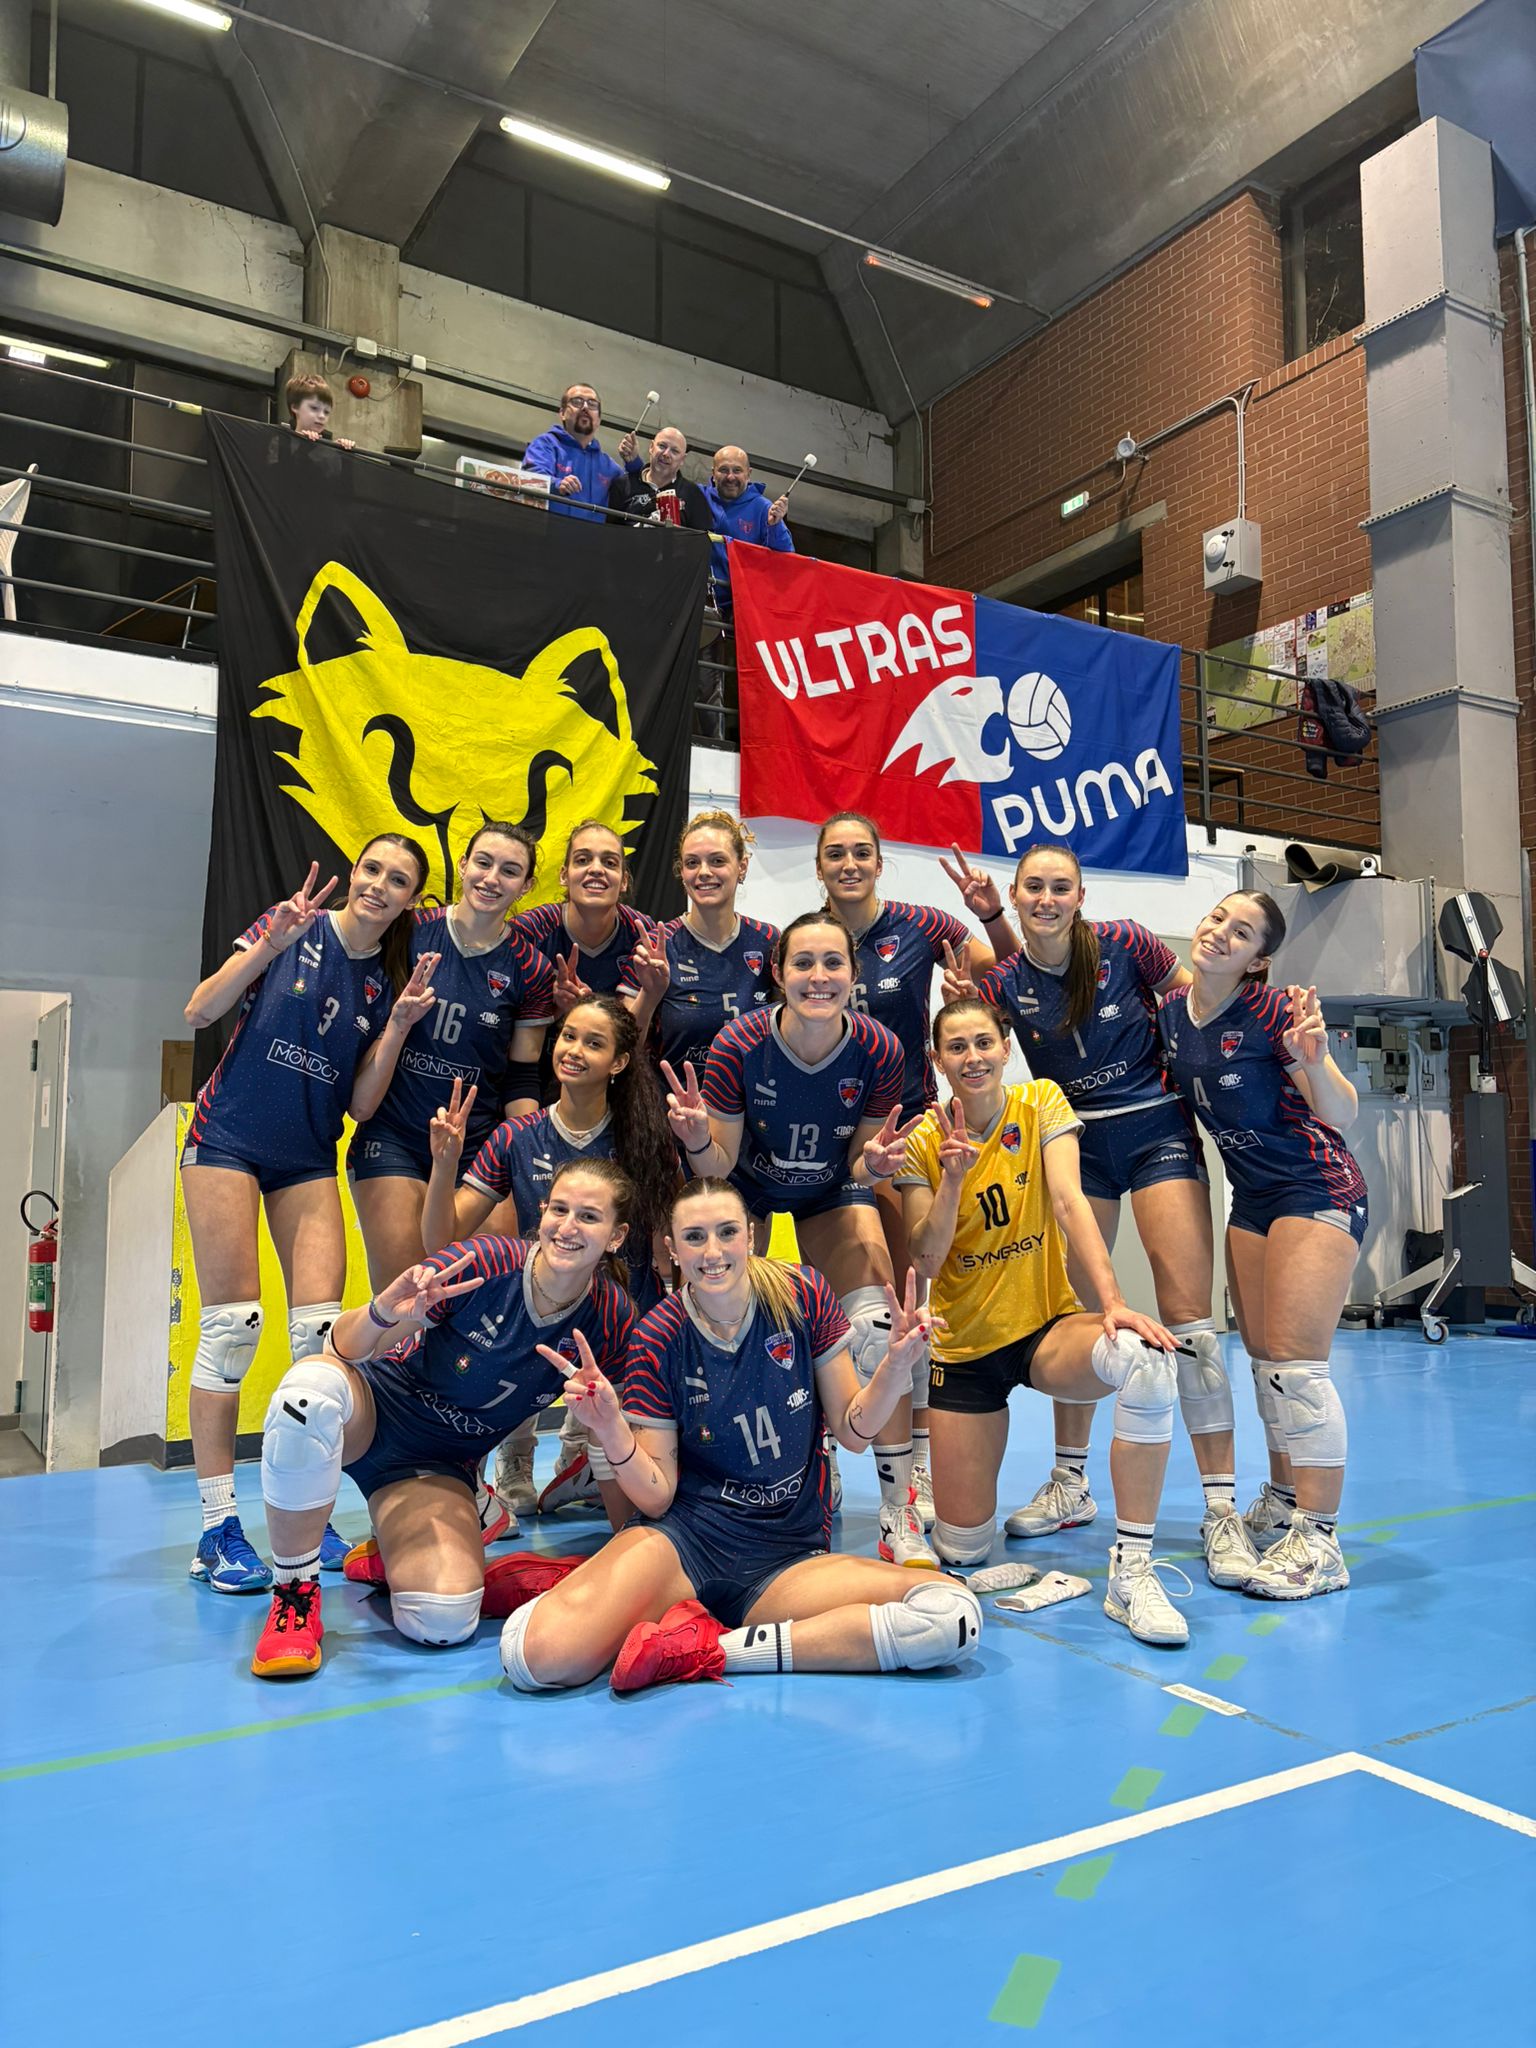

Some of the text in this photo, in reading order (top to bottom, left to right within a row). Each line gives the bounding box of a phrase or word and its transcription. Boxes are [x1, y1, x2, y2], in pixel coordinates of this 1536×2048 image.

[755, 604, 973, 700] ULTRAS
[990, 748, 1175, 855] PUMA
[298, 954, 320, 969] nine
[680, 975, 700, 983] nine
[317, 996, 340, 1037] 3
[432, 997, 467, 1045] 16
[722, 992, 740, 1023] 5
[1019, 1006, 1040, 1016] nine
[274, 1045, 336, 1080] MONDO
[754, 1098, 777, 1107] nine
[1192, 1077, 1214, 1115] 4
[788, 1123, 820, 1161] 13
[1160, 1152, 1189, 1162] nine
[532, 1172, 553, 1181] nine
[975, 1182, 1011, 1232] 10
[468, 1330, 494, 1349] nine
[478, 1379, 518, 1409] 7
[688, 1392, 711, 1406] nine
[732, 1405, 782, 1466] 14
[729, 1476, 803, 1506] MONDO
